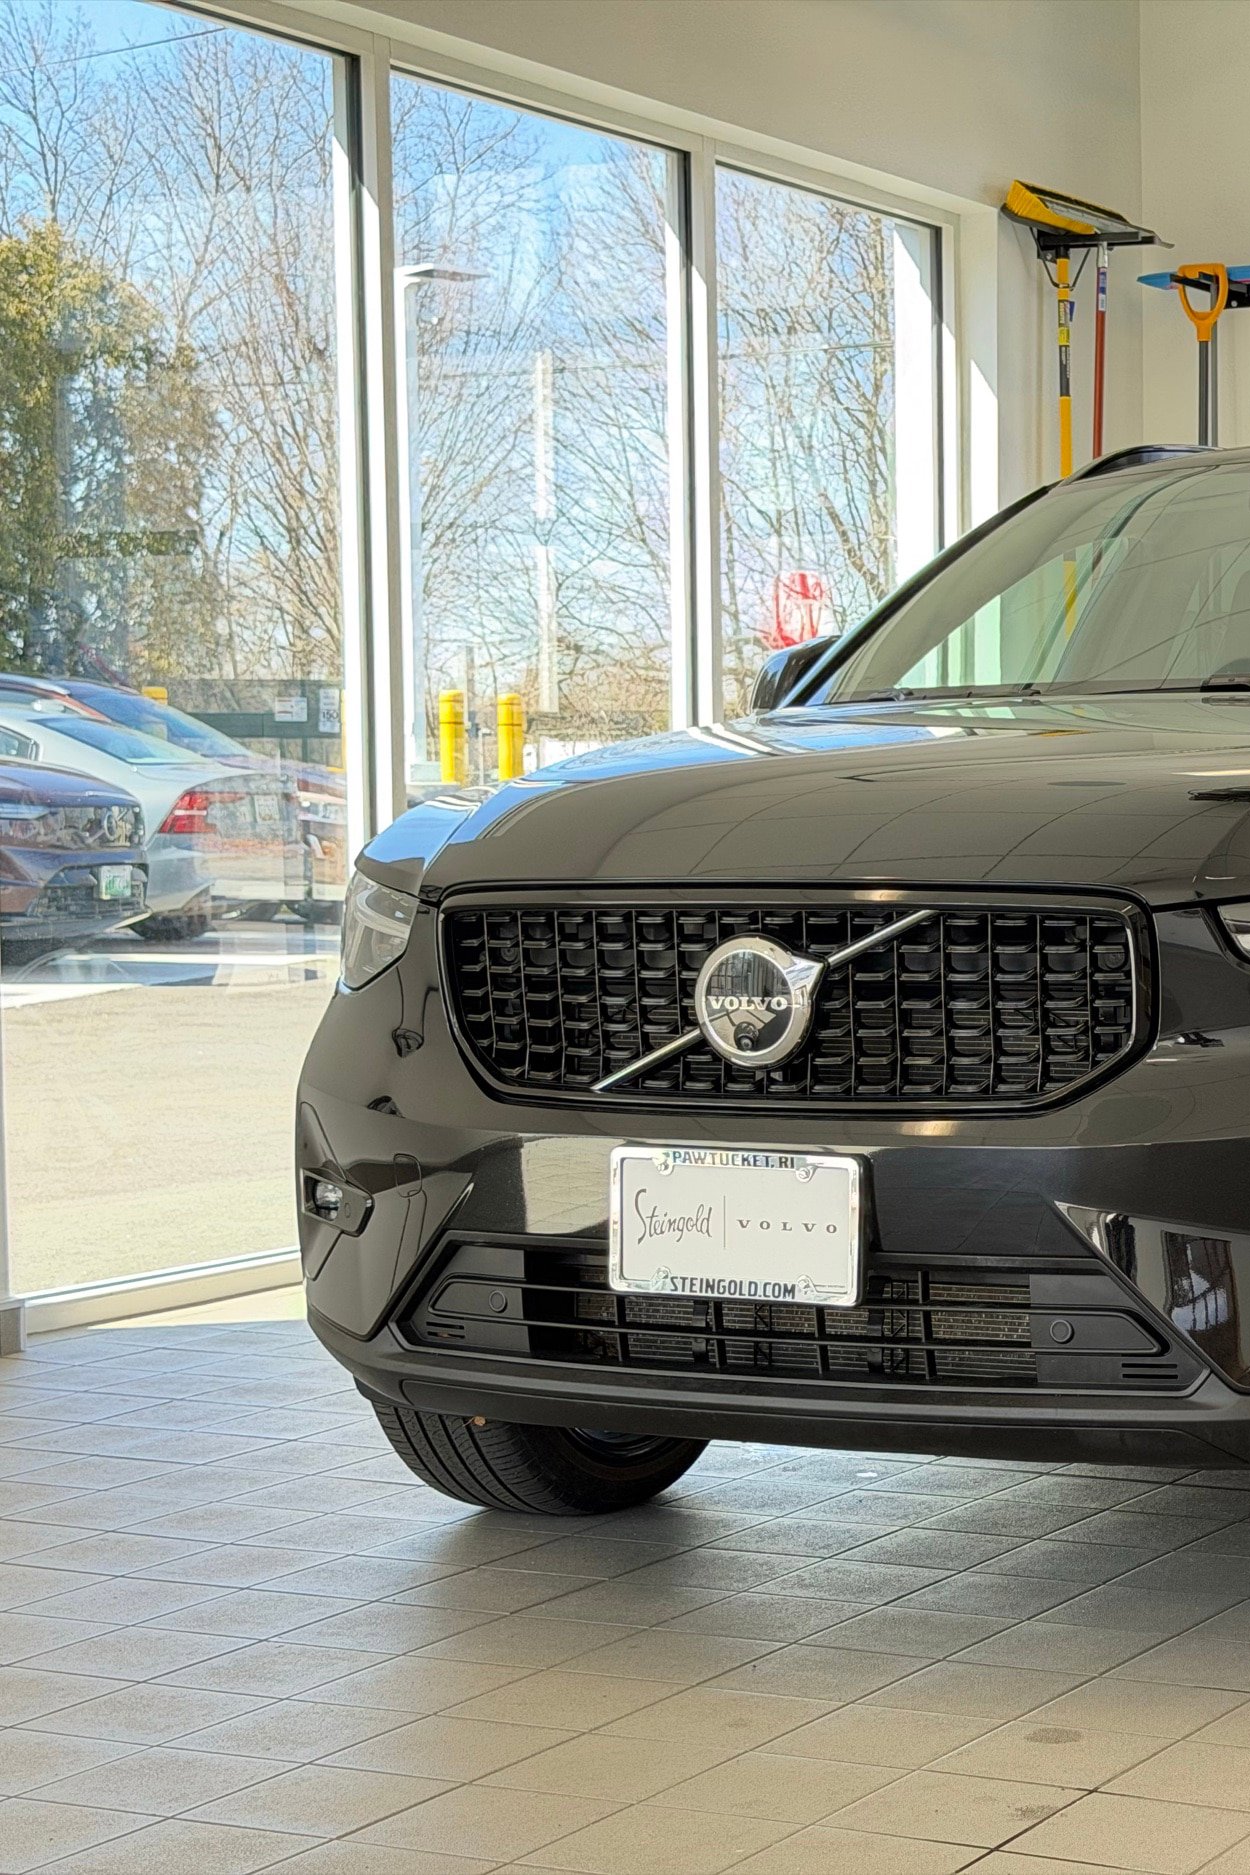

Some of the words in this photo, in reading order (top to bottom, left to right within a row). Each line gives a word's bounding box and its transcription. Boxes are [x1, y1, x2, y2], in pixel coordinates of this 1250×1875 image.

[707, 995, 788, 1011] VOLVO
[779, 1156, 796, 1169] RI
[634, 1188, 713, 1245] Steingold
[736, 1218, 838, 1235] VOLVO
[670, 1276, 796, 1300] STEINGOLD.COM
